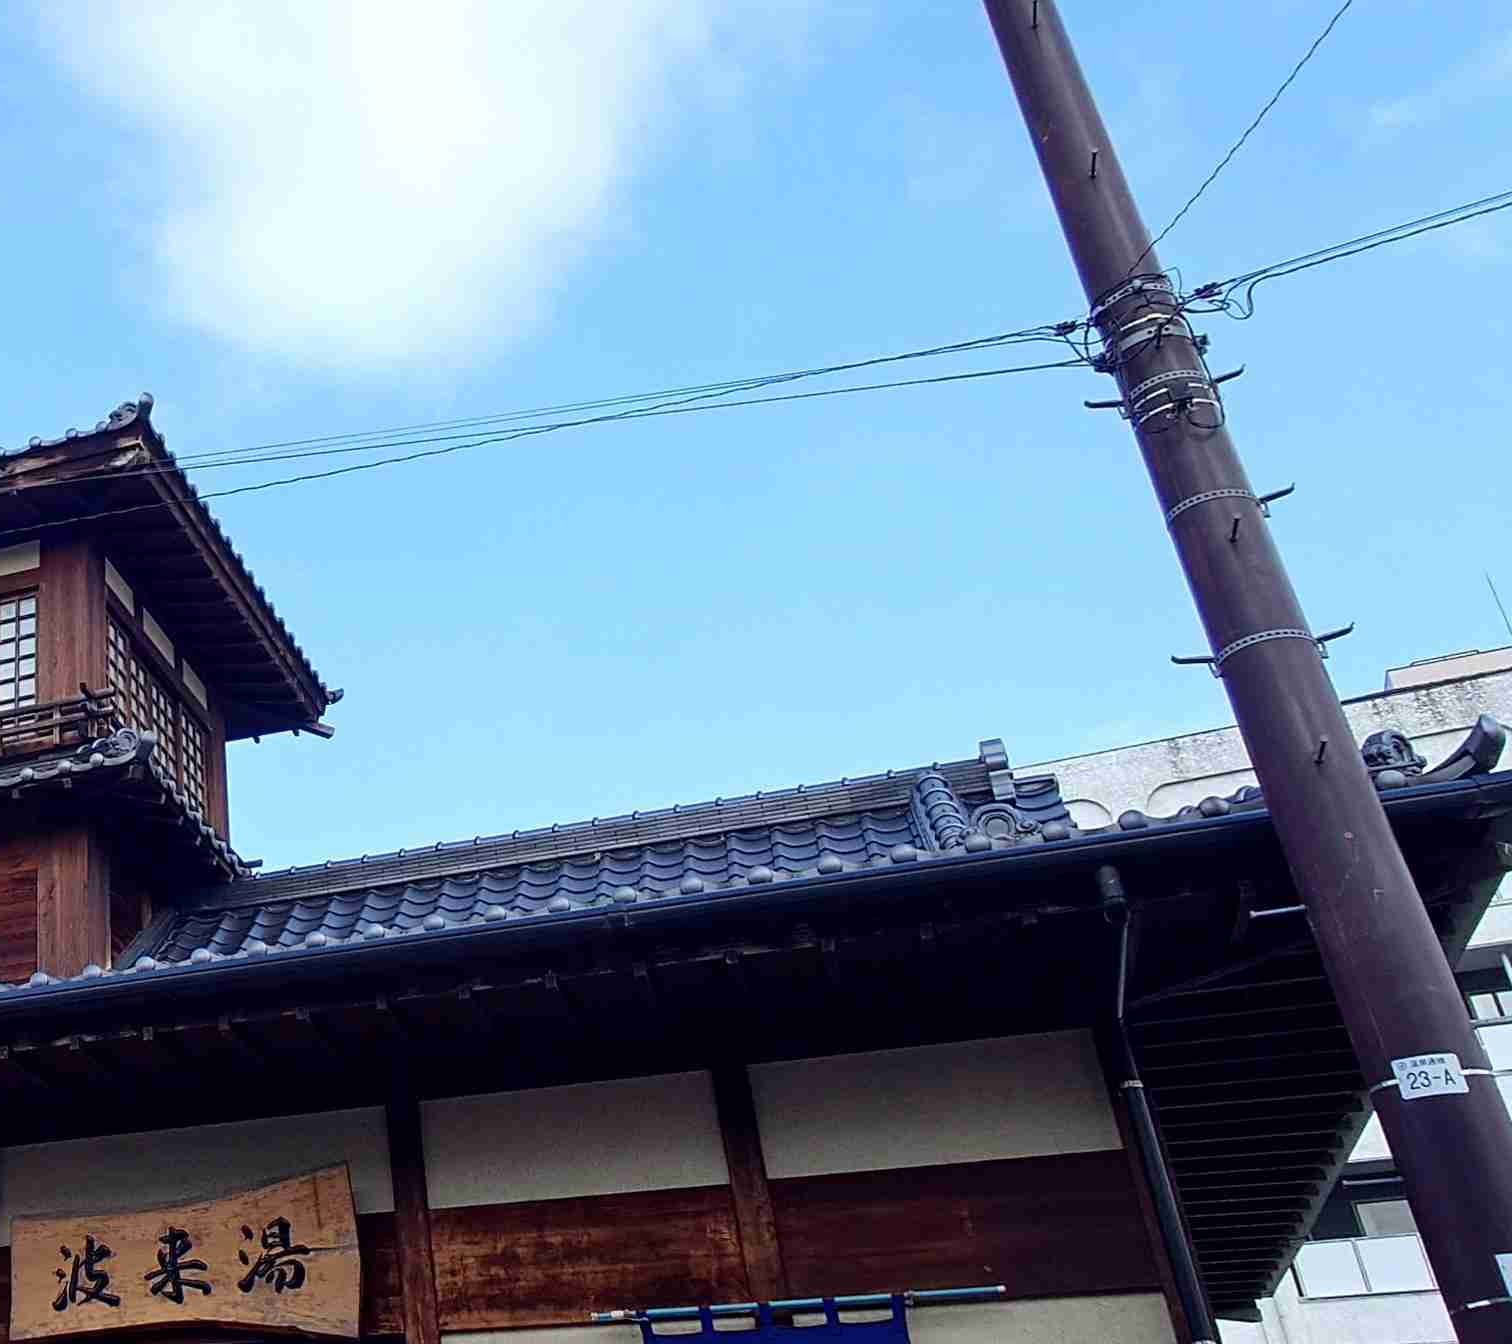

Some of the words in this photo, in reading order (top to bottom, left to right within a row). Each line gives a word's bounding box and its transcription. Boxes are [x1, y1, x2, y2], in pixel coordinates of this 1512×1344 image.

[1406, 1068, 1457, 1090] 23-A
[51, 1214, 312, 1313] 波来湯
